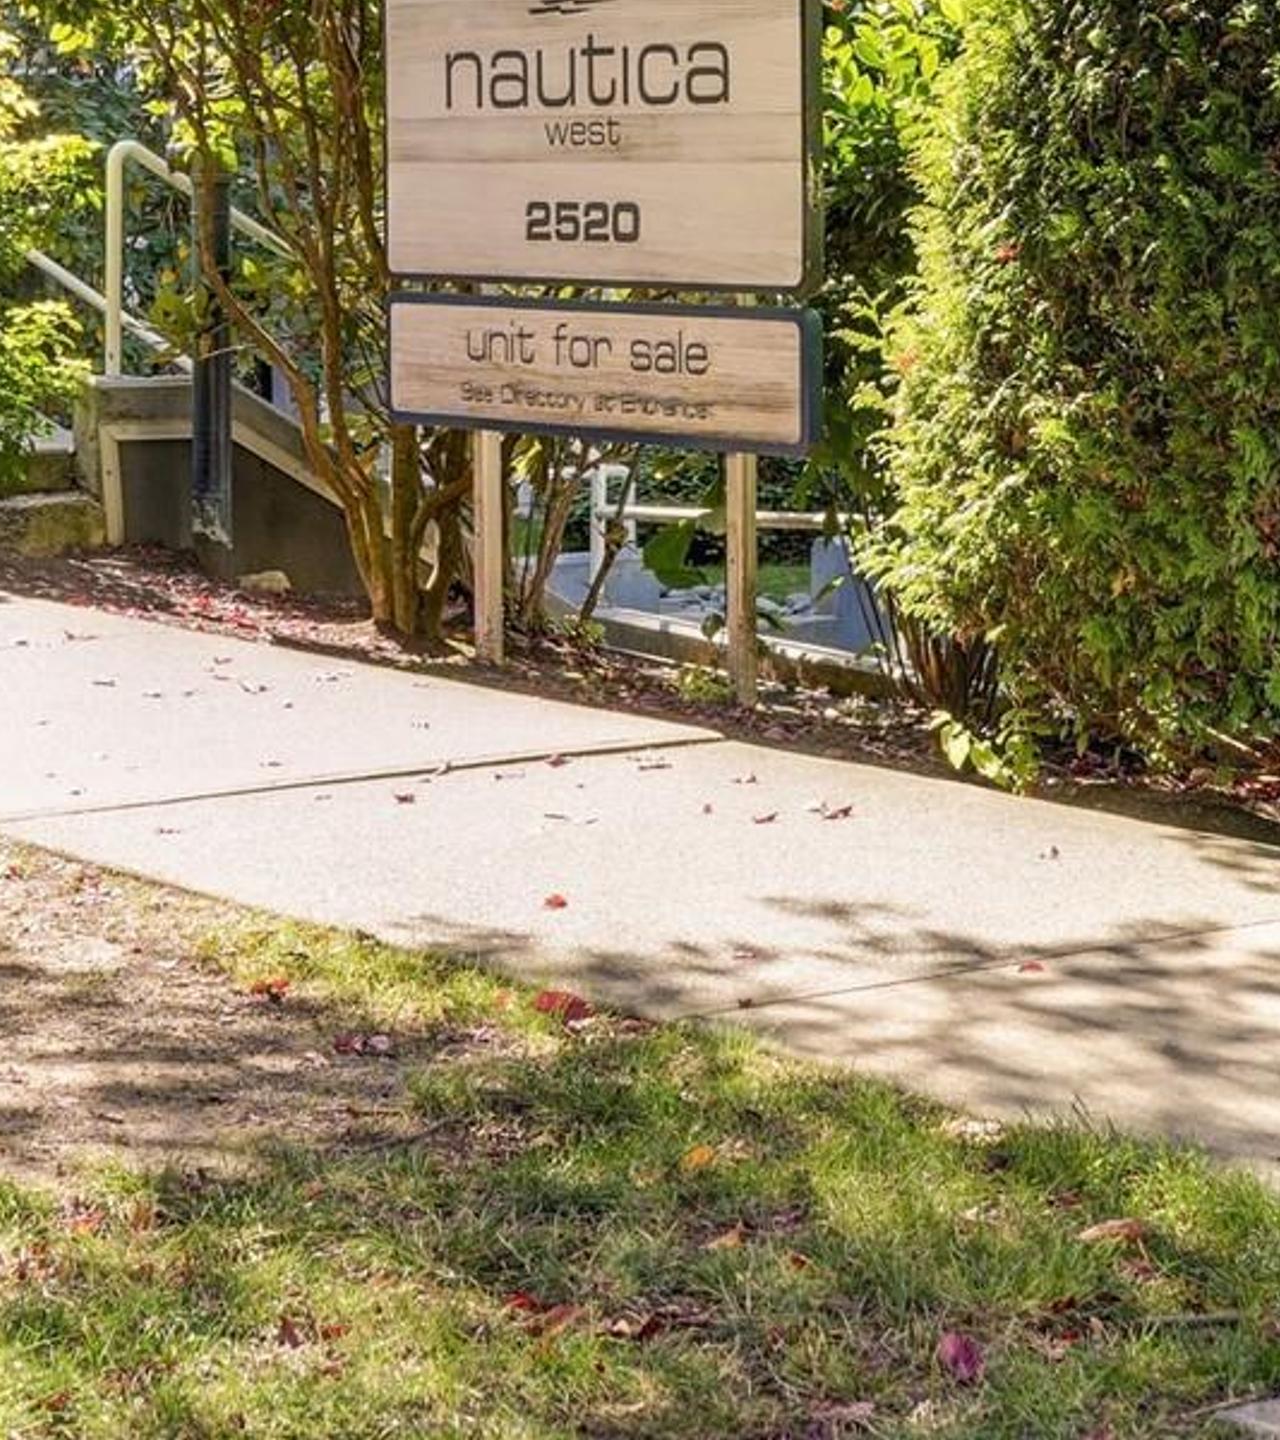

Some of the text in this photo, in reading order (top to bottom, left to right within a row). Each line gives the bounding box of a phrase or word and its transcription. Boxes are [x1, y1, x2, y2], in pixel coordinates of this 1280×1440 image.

[444, 33, 731, 109] nautica
[544, 116, 621, 146] west
[525, 201, 641, 243] 2520
[466, 320, 710, 376] unit for sale
